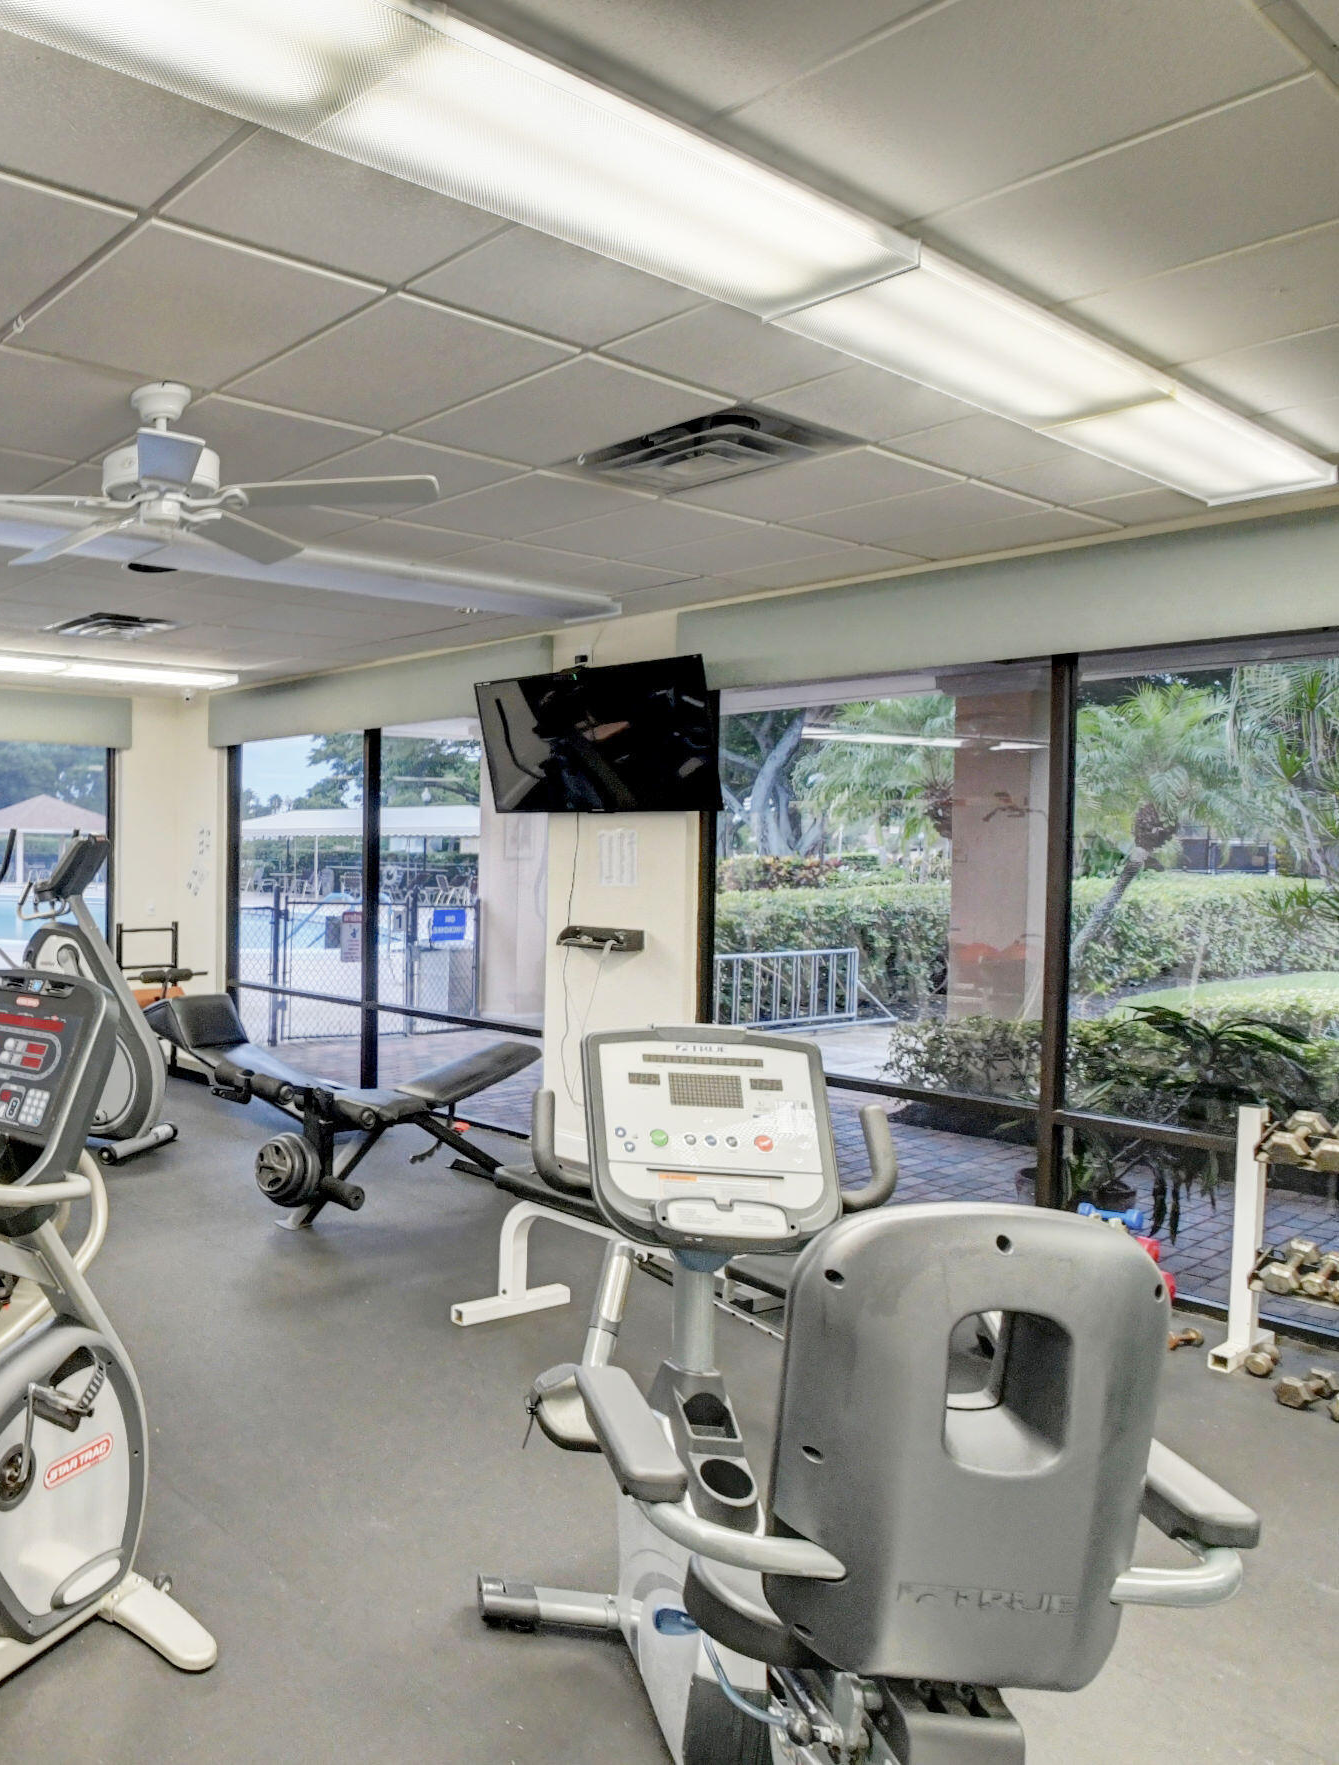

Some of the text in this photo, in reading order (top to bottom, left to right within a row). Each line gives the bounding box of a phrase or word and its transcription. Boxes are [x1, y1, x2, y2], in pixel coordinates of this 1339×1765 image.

[395, 913, 402, 929] 1
[48, 1441, 108, 1483] STAR TRAC
